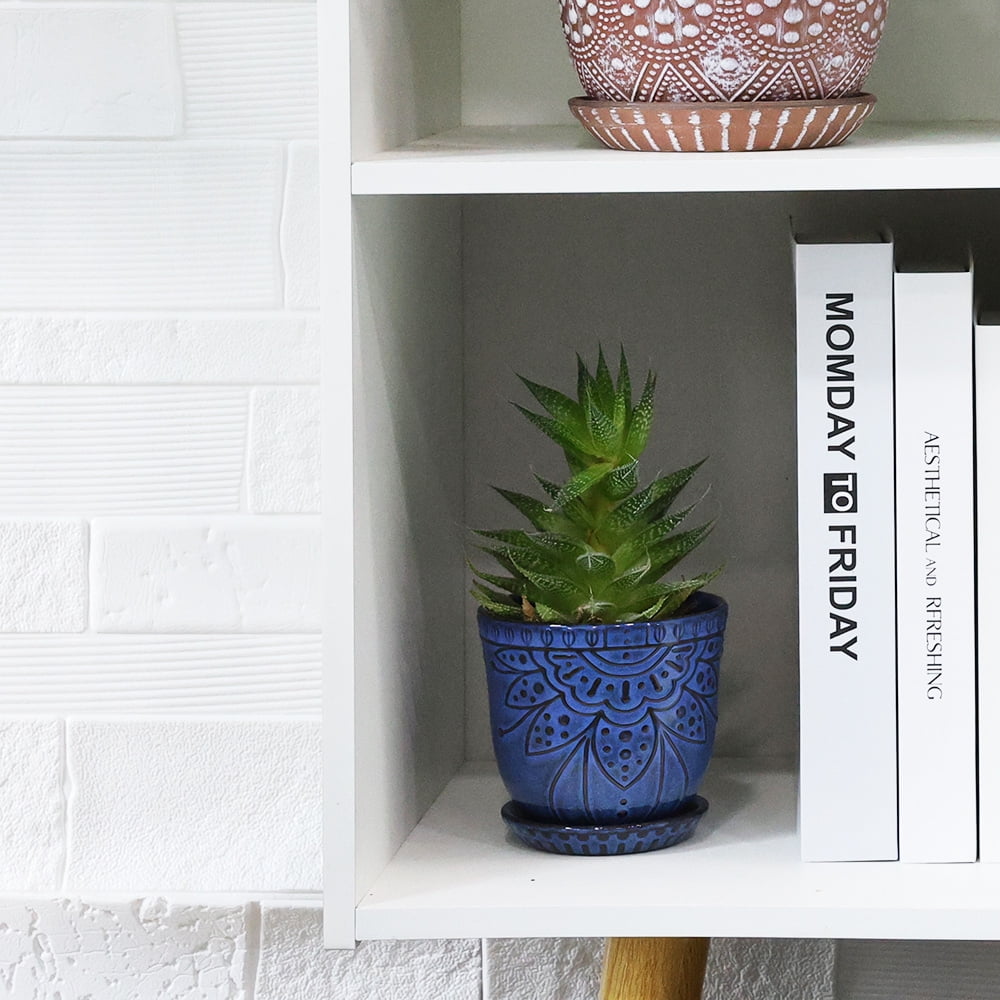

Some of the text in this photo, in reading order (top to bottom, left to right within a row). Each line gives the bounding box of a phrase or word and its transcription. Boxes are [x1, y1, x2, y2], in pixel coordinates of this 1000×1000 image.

[825, 292, 858, 661] MOMDAY TO FRIDAY
[924, 431, 941, 553] AESTHETICAL
[925, 558, 937, 587] AND
